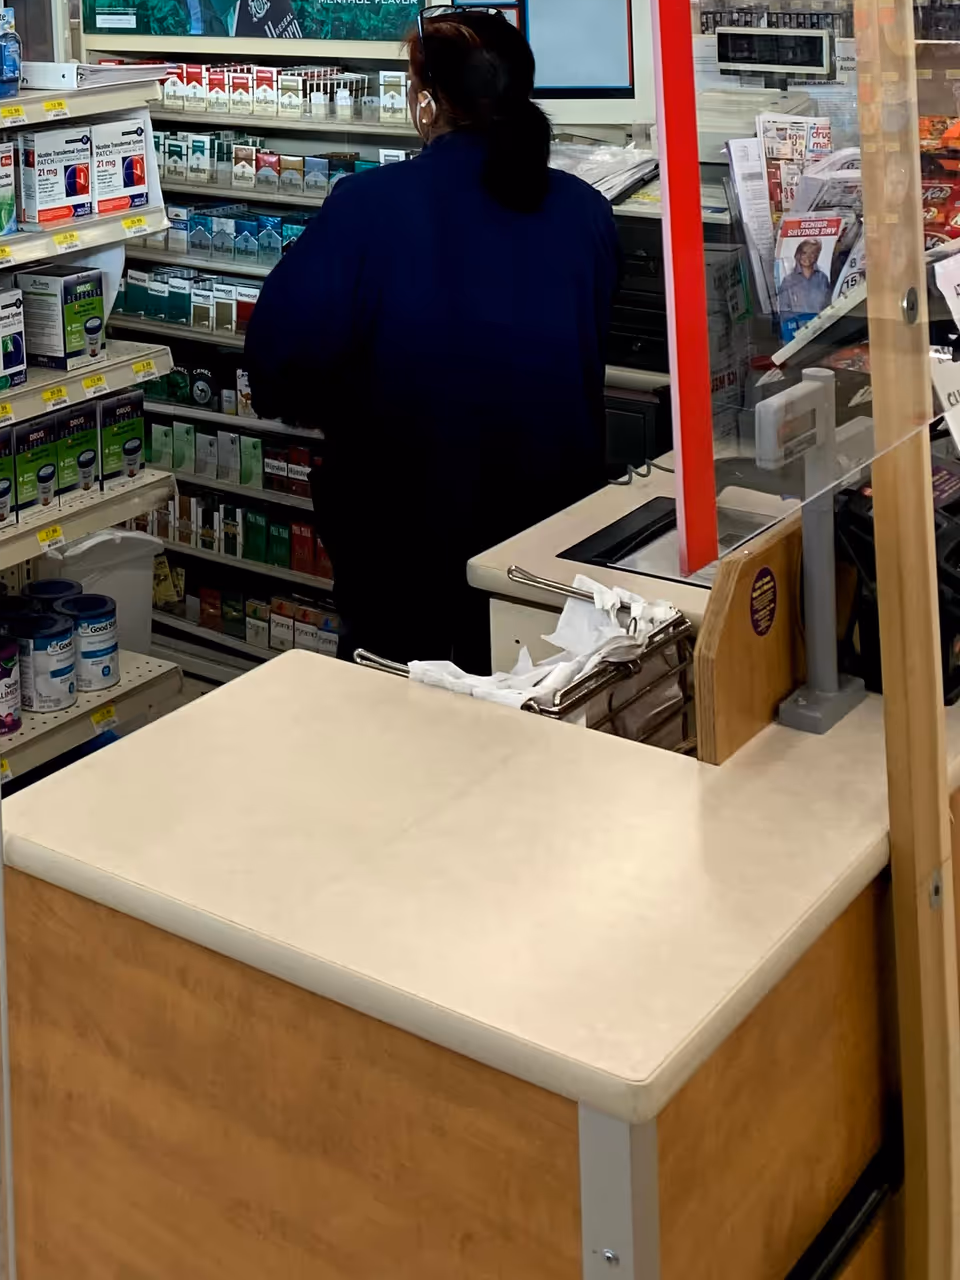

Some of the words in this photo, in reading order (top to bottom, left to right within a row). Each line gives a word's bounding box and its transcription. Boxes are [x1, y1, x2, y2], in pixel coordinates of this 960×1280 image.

[799, 220, 828, 229] SENIOR
[787, 228, 820, 236] SAVINGS
[821, 227, 837, 235] DAY
